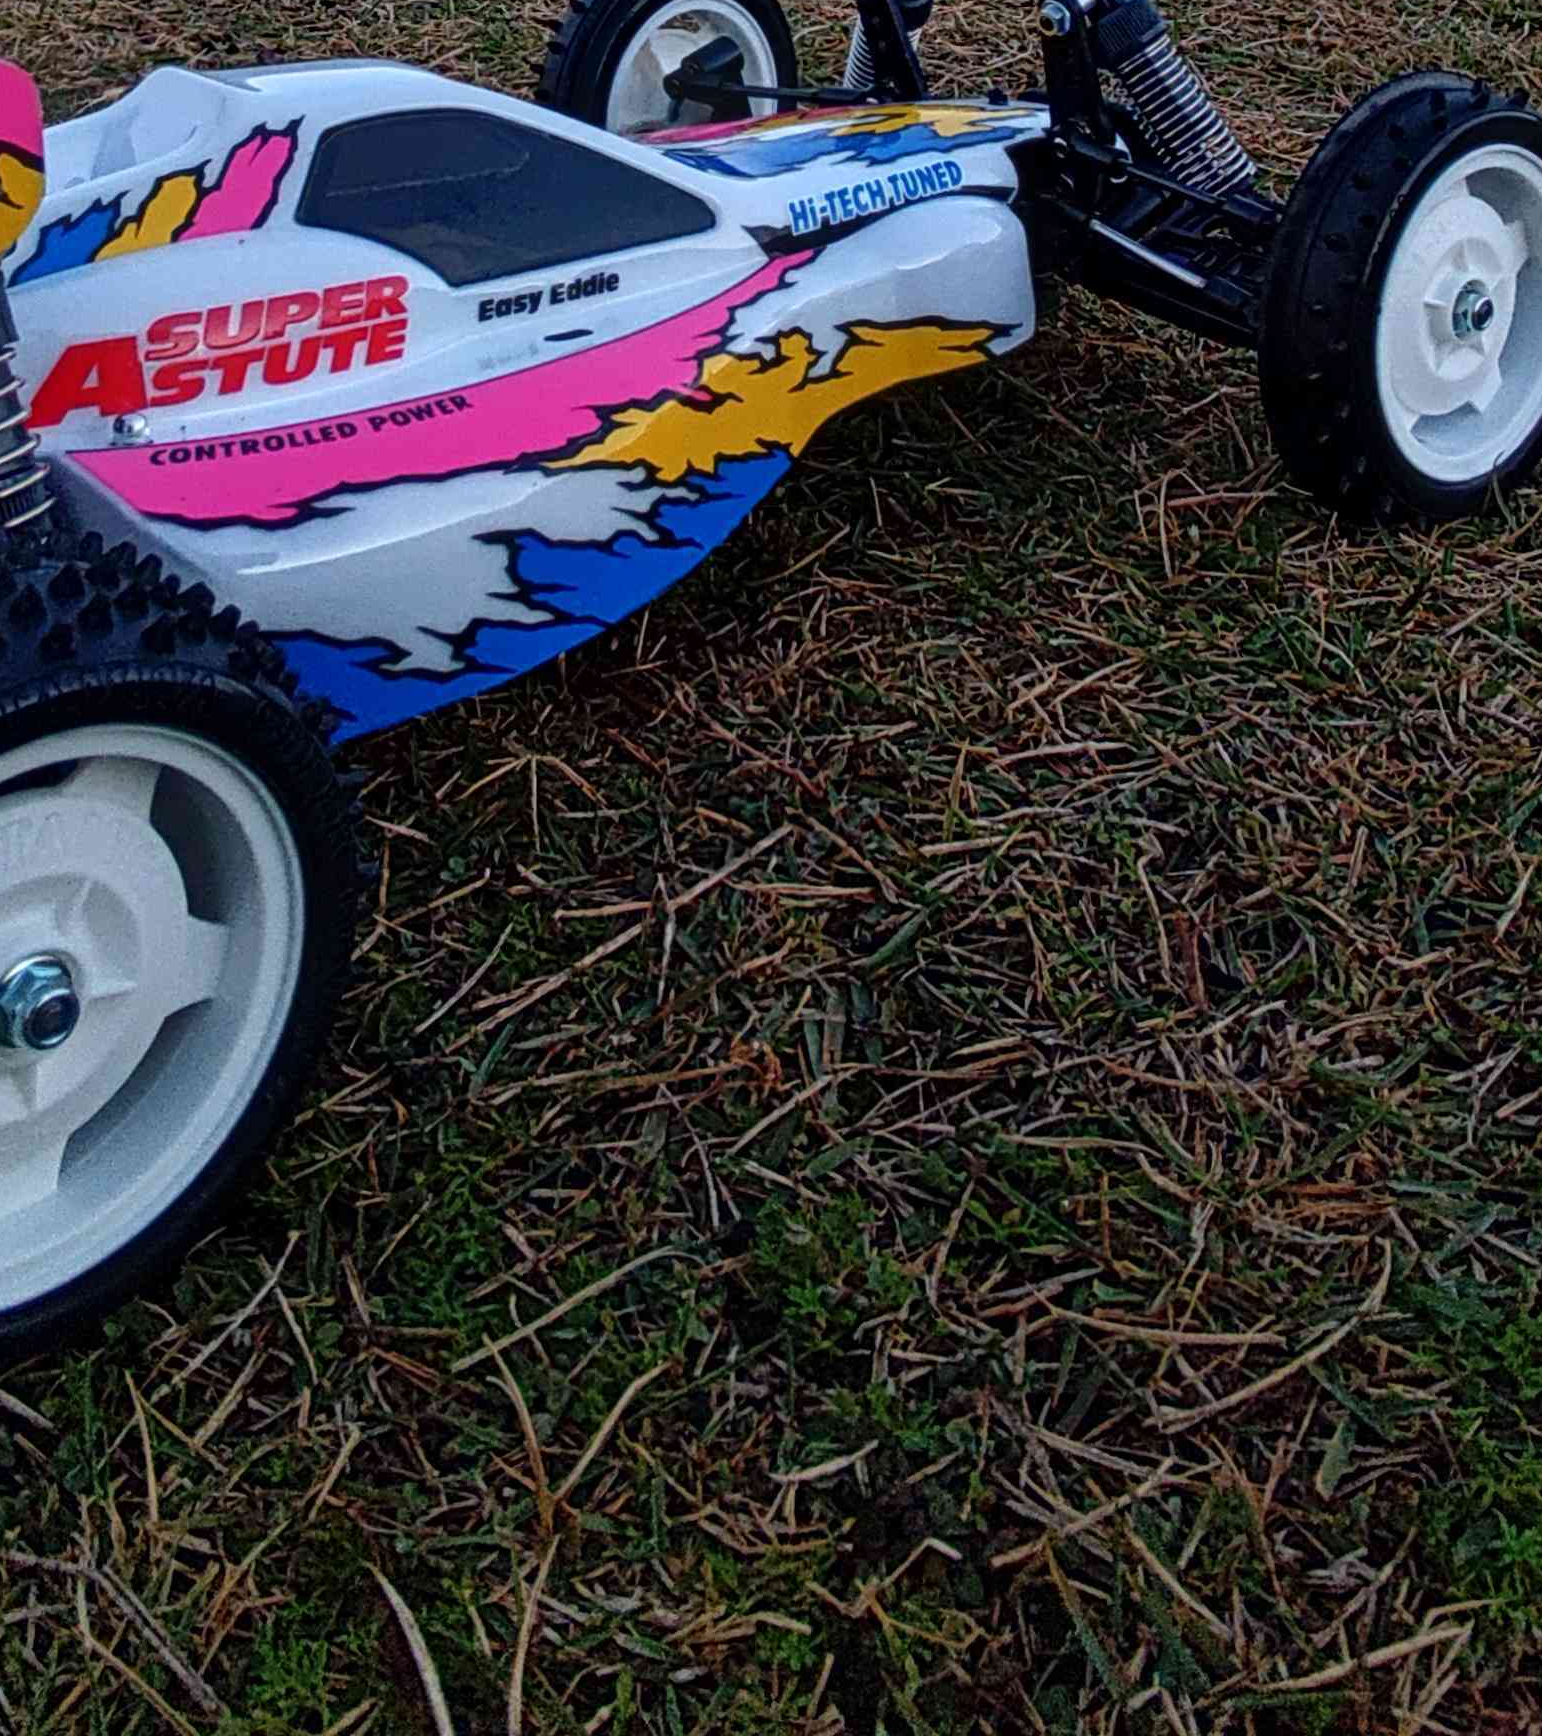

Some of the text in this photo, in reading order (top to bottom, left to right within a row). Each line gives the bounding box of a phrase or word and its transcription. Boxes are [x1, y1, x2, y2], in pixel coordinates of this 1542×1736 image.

[788, 160, 964, 234] Hi-TECH TUNED
[145, 274, 410, 362] SUPER
[478, 272, 620, 322] Easy Eddie
[26, 318, 409, 429] ASTUTE
[149, 394, 473, 466] CONTROLLED POWER
